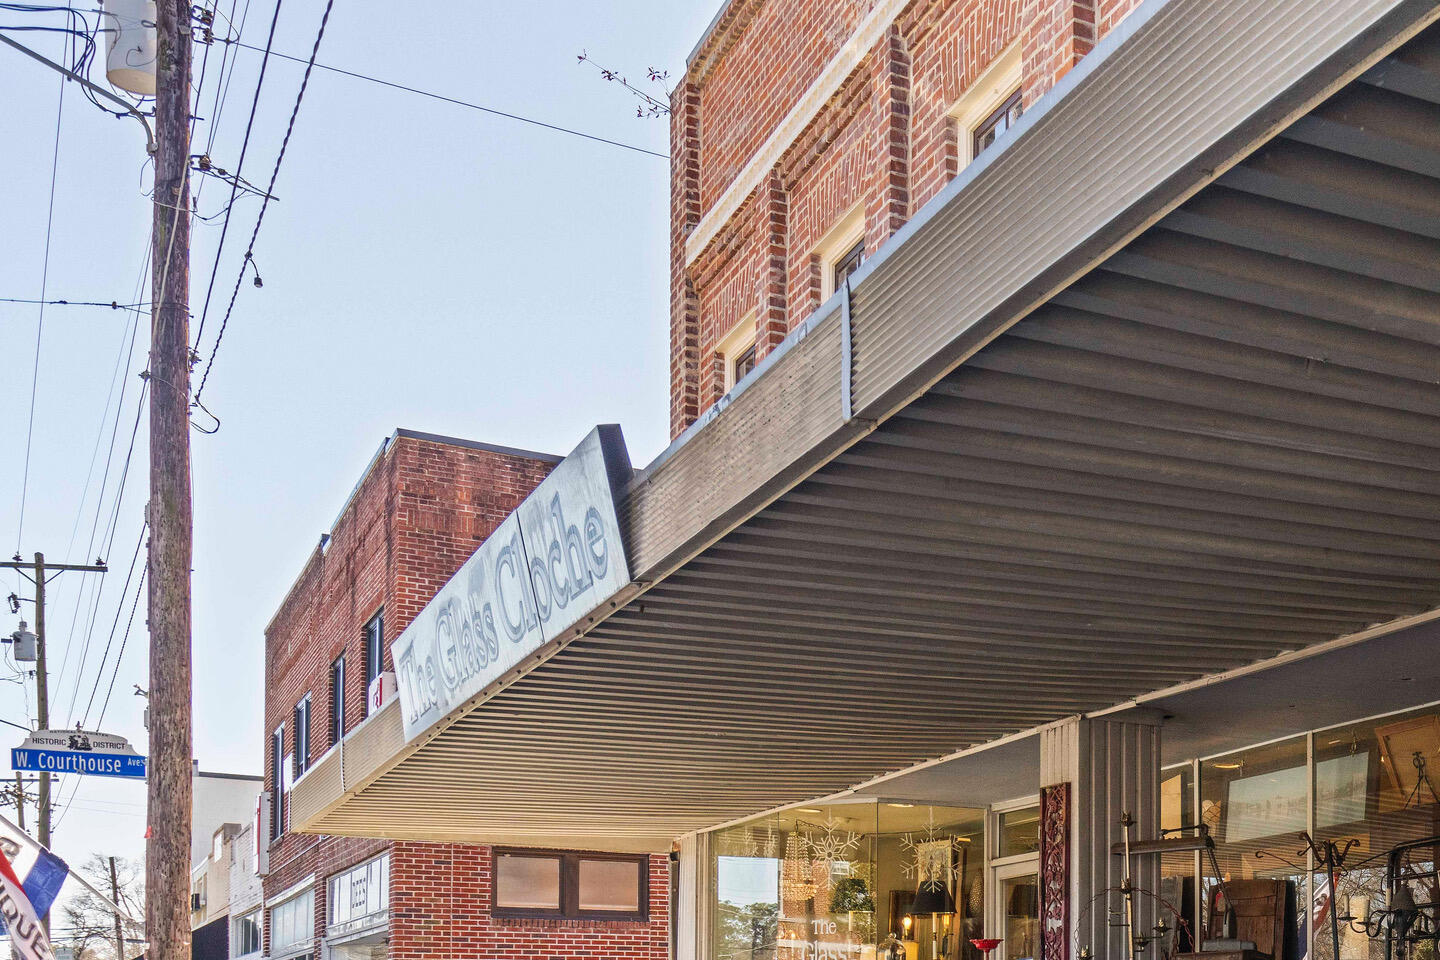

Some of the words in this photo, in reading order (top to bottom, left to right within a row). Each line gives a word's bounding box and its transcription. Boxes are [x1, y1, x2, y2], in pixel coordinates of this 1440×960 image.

[399, 640, 439, 725] The
[435, 597, 499, 692] Glass
[495, 490, 609, 644] Cloche
[32, 738, 67, 746] HISTORIC
[93, 741, 126, 750] DISTRICT
[15, 751, 32, 768] W.
[38, 752, 122, 773] Courthouse
[127, 758, 144, 767] Ave.
[811, 919, 838, 935] The
